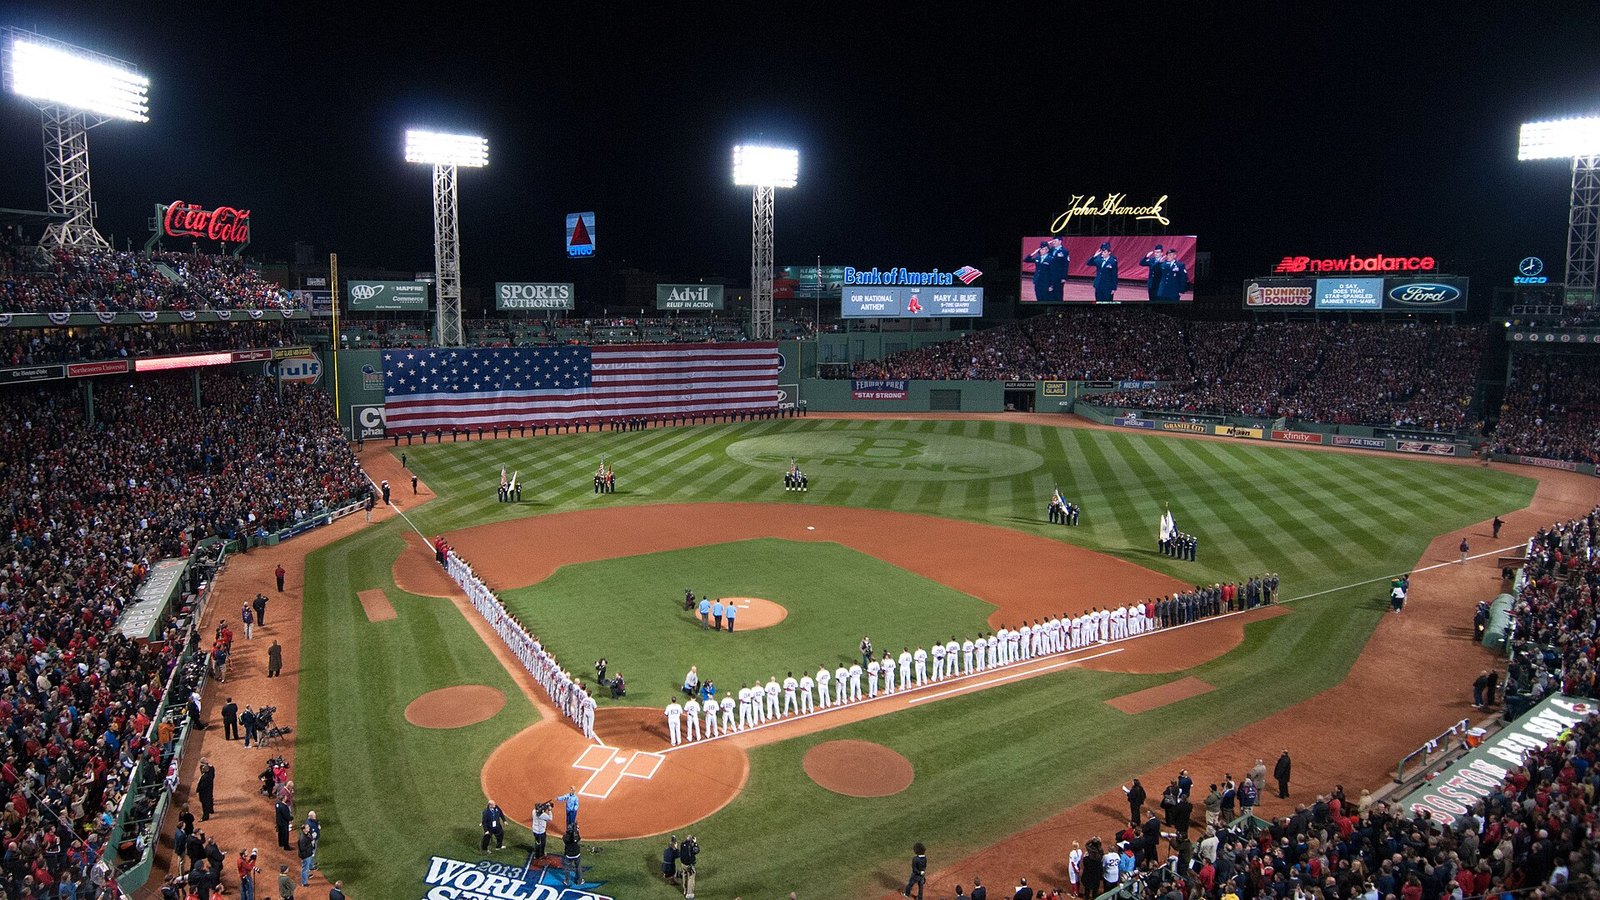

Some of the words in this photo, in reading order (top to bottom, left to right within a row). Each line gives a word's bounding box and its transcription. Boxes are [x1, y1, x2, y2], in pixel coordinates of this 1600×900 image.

[1050, 194, 1098, 233] John
[1097, 192, 1170, 226] Hancock
[164, 200, 250, 242] Coca-Cola
[569, 245, 593, 256] CITGO
[1310, 259, 1349, 271] new
[1349, 254, 1435, 271] balance
[844, 267, 883, 285] Bank
[883, 267, 899, 285] of
[898, 267, 953, 286] America
[354, 286, 372, 298] AAA
[501, 284, 569, 299] SPORTS
[667, 287, 708, 301] Advil
[1265, 287, 1311, 297] DUNKIN'
[1402, 286, 1447, 301] Ford
[502, 299, 568, 308] AUTHORITY
[934, 294, 952, 302] MARY
[952, 294, 959, 302] J.
[959, 294, 977, 302] BLIGE
[1264, 296, 1309, 305] DONUTS
[860, 303, 885, 311] ANTHEM
[70, 366, 102, 374] Northeastern
[102, 364, 126, 373] University
[268, 362, 319, 376] Gulf
[856, 381, 884, 390] FENWAY
[886, 381, 905, 390] PARK
[360, 407, 386, 428] CV
[1123, 418, 1144, 427] jetBlue
[1164, 422, 1190, 430] GRANITE
[1227, 428, 1251, 436] Nkon
[1283, 432, 1310, 442] xfinity
[1363, 439, 1385, 447] TICKET
[756, 453, 990, 475] STRONG
[1409, 758, 1508, 826] BOSTON
[1109, 858, 1119, 867] 23
[475, 861, 523, 878] 2013
[425, 856, 559, 900] WORLD
